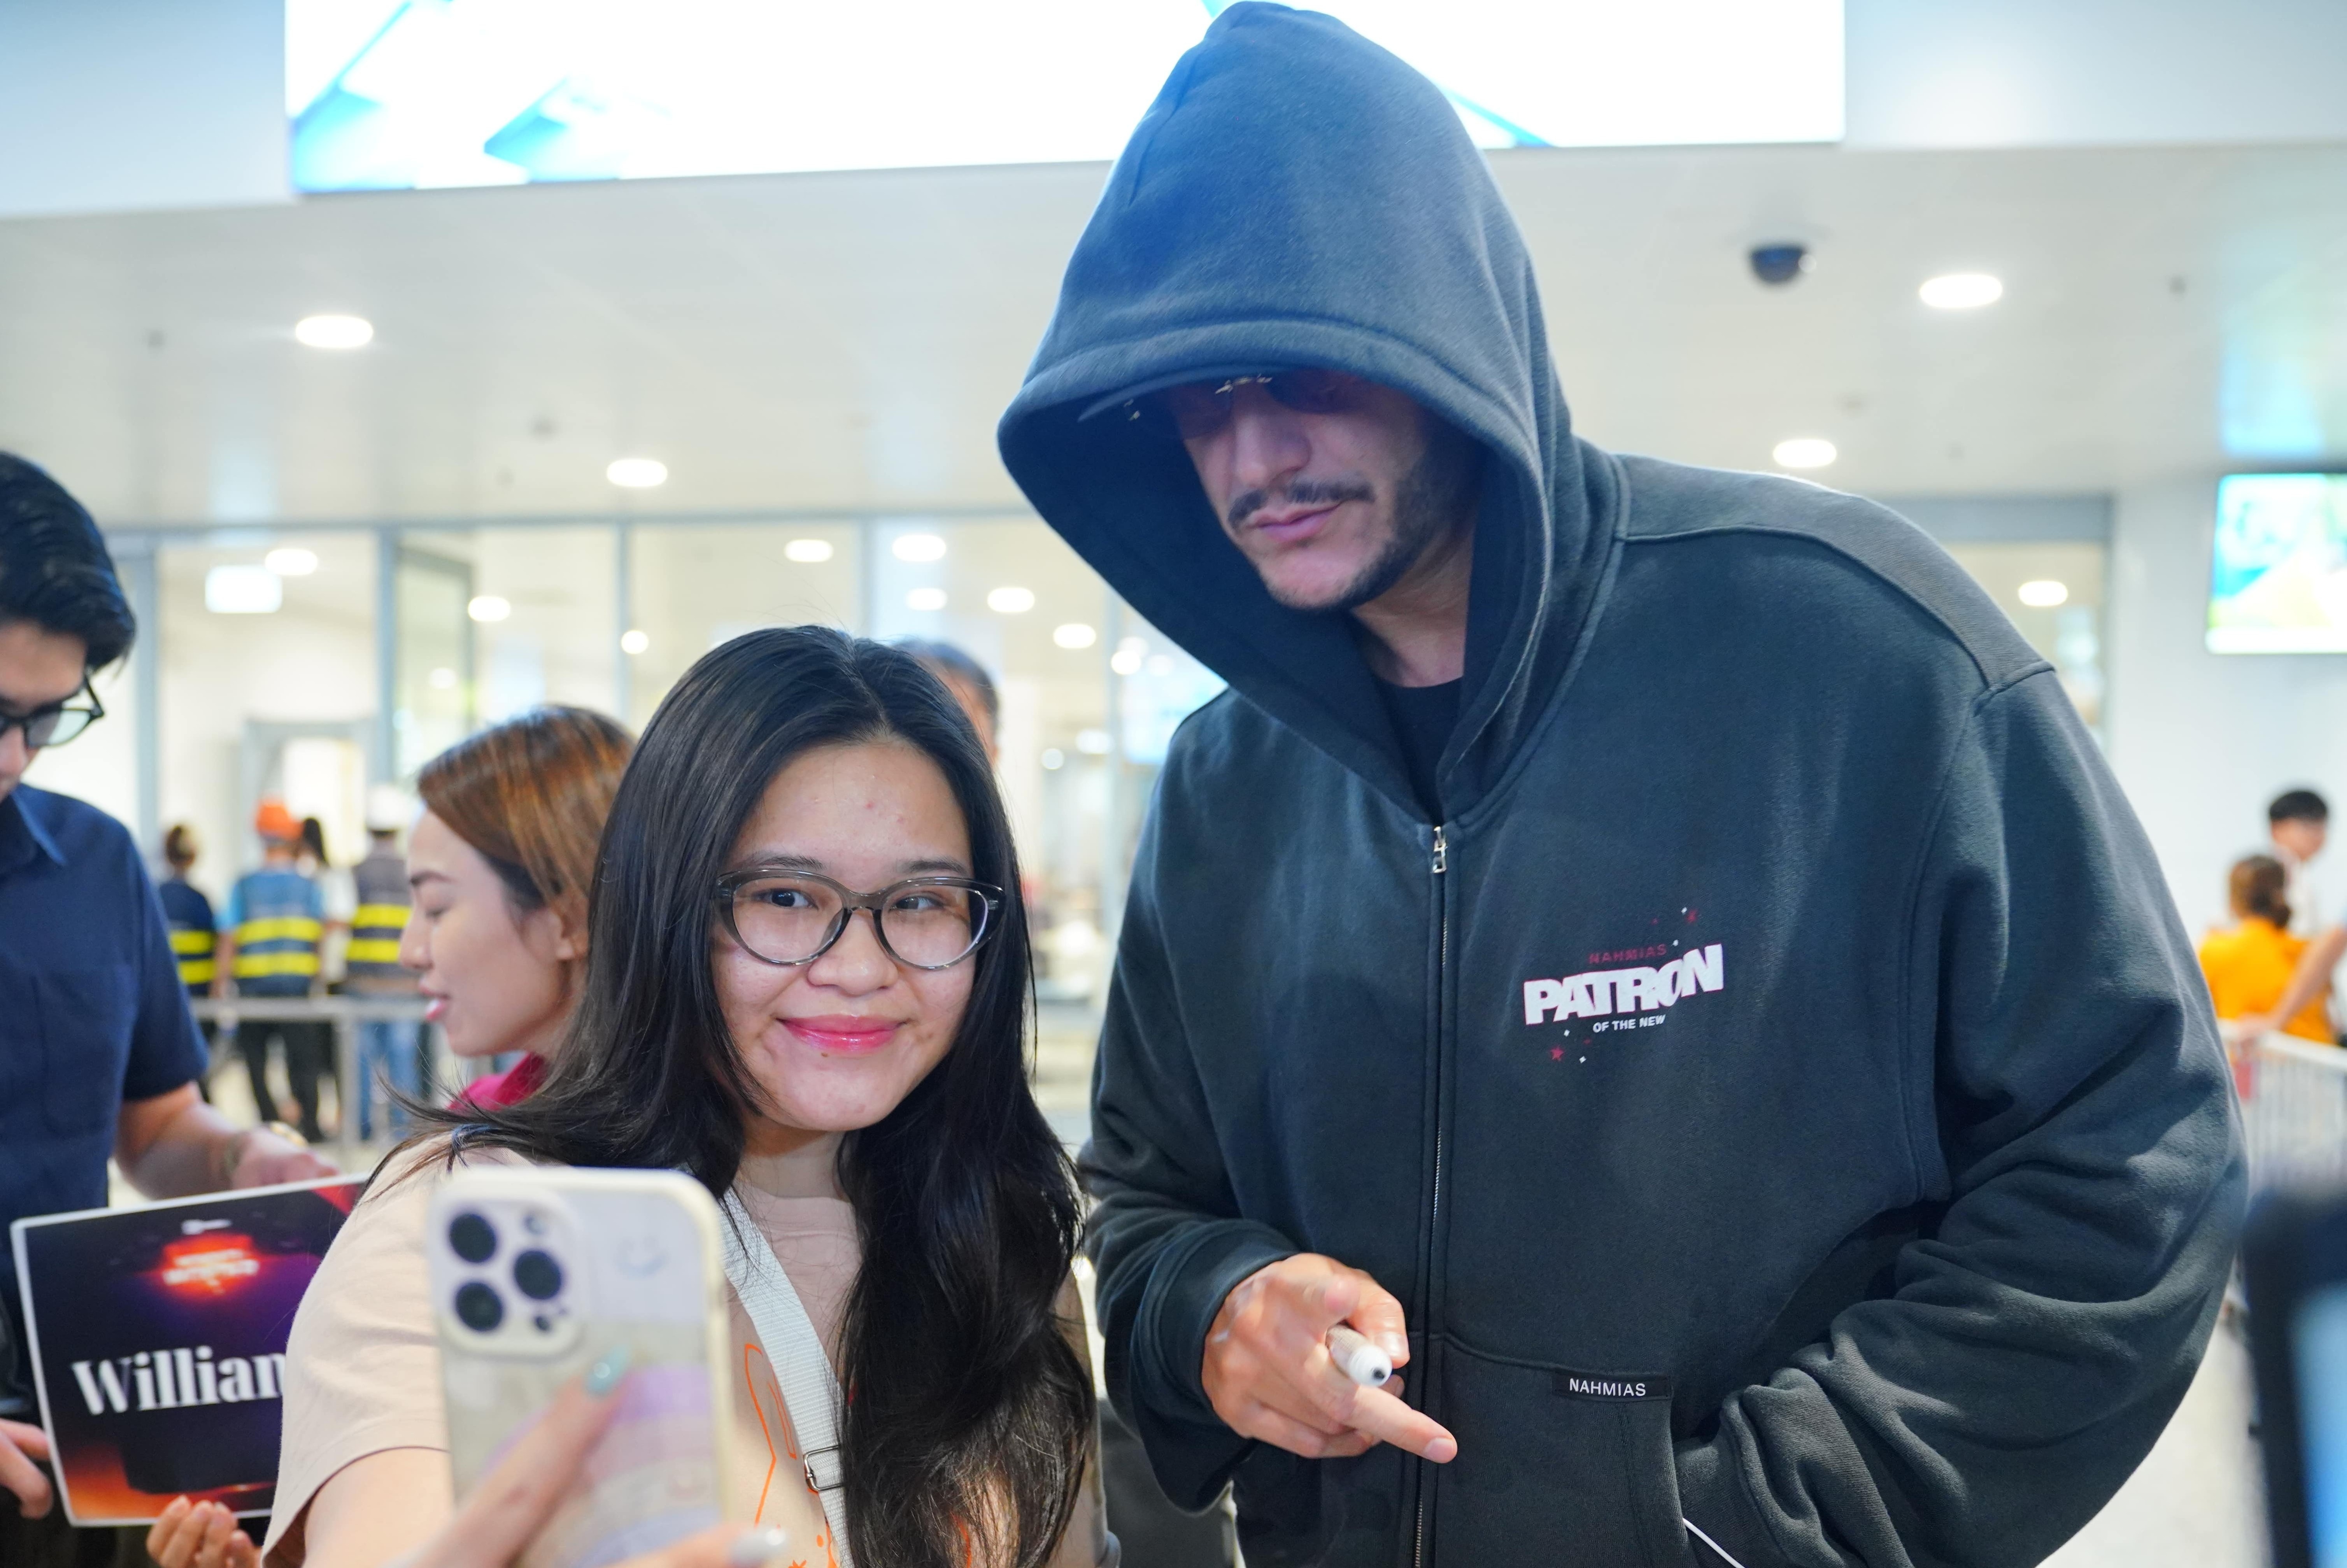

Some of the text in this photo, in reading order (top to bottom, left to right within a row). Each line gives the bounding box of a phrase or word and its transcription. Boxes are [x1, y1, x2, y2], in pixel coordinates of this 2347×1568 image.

[1589, 944, 1667, 964] NAHMIAS
[1524, 944, 1724, 1025] PATRON
[1593, 1014, 1666, 1033] OF THE NEW
[1569, 1378, 1646, 1396] NAHMIAS
